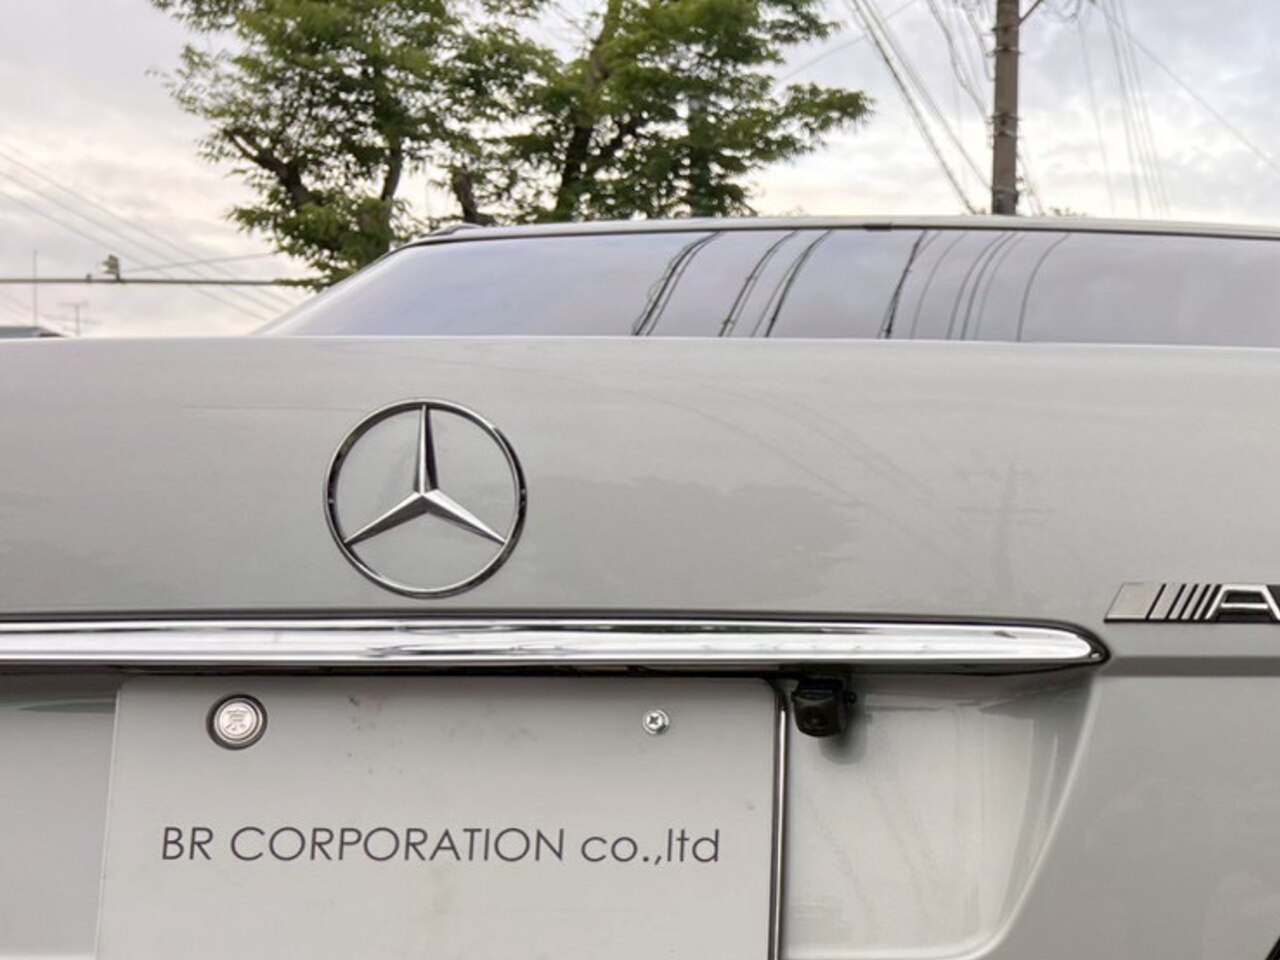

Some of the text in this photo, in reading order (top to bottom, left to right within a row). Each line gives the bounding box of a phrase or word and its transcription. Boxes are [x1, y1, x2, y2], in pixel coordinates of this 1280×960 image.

[162, 826, 720, 866] BR CORPORATION co.,ltd
